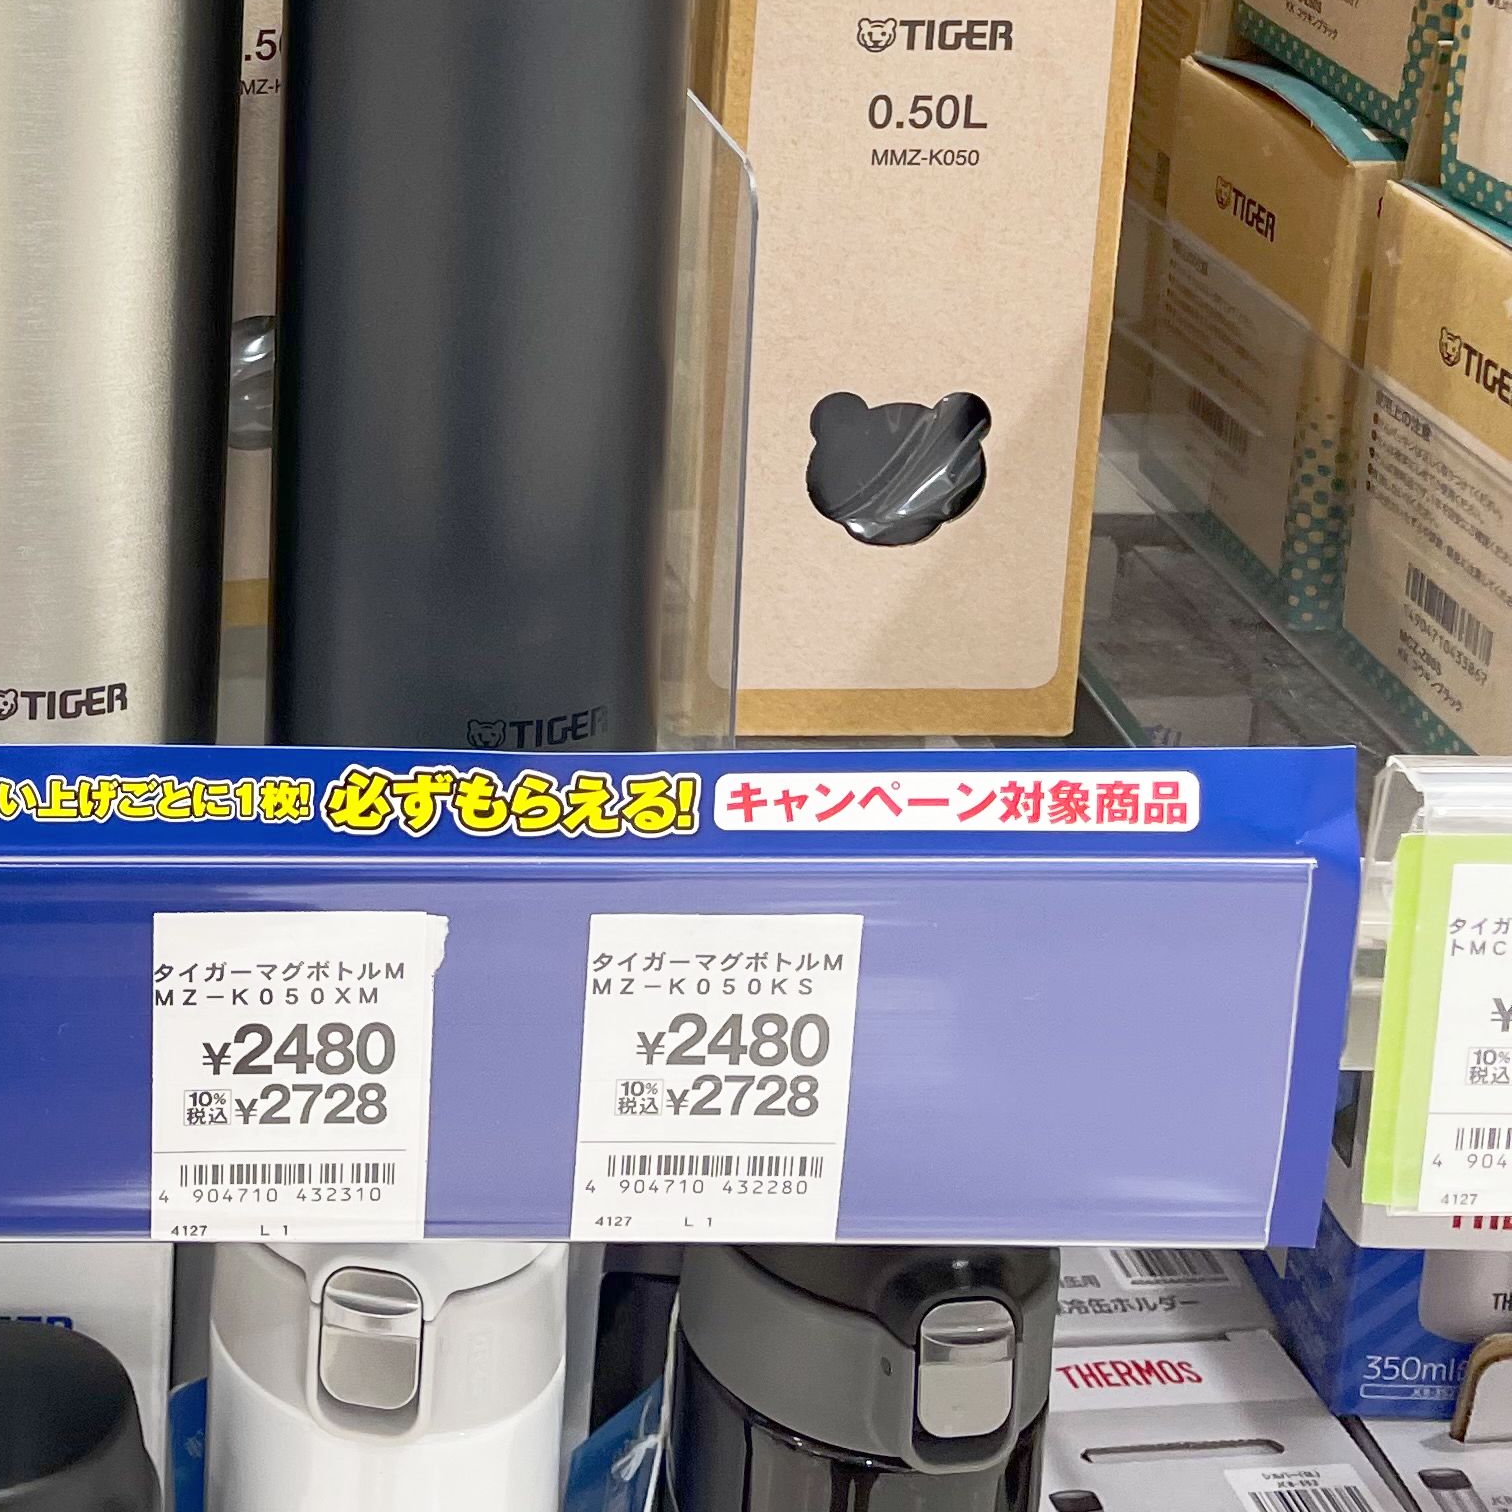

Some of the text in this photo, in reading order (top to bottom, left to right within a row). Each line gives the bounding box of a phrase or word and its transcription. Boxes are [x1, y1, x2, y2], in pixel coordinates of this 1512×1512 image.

[899, 19, 1013, 51] TIGER
[868, 94, 988, 129] 0.50L
[871, 149, 980, 166] MMZ-K050
[1232, 187, 1276, 242] TIGER
[19, 683, 128, 721] TIGER
[509, 705, 609, 749] TIGER
[327, 768, 699, 835] 必ずもらえる!
[726, 779, 1187, 825] キャンペーン対象商品
[154, 961, 405, 983] タイガーマグボトルM
[593, 951, 843, 973] タイガーマグボトルM
[202, 1022, 396, 1076] ¥2480
[636, 1012, 830, 1067] ¥2480
[1473, 1049, 1510, 1066] 10%
[1469, 1066, 1511, 1085] 税込
[188, 1092, 226, 1107] 10%
[620, 1081, 658, 1096] 10%
[666, 1074, 819, 1117] ¥2728
[234, 1082, 387, 1125] ¥2728
[617, 1096, 658, 1115] 税込
[186, 1107, 228, 1125] 税込
[158, 1187, 381, 1203] 4 904710 432310
[585, 1180, 808, 1195] 4 904710 432280
[1440, 1193, 1479, 1206] 4127
[171, 1225, 208, 1237] 4127
[595, 1216, 632, 1227] 4127
[1056, 1358, 1204, 1389] THERMOS
[1363, 1355, 1468, 1383] 350ml
